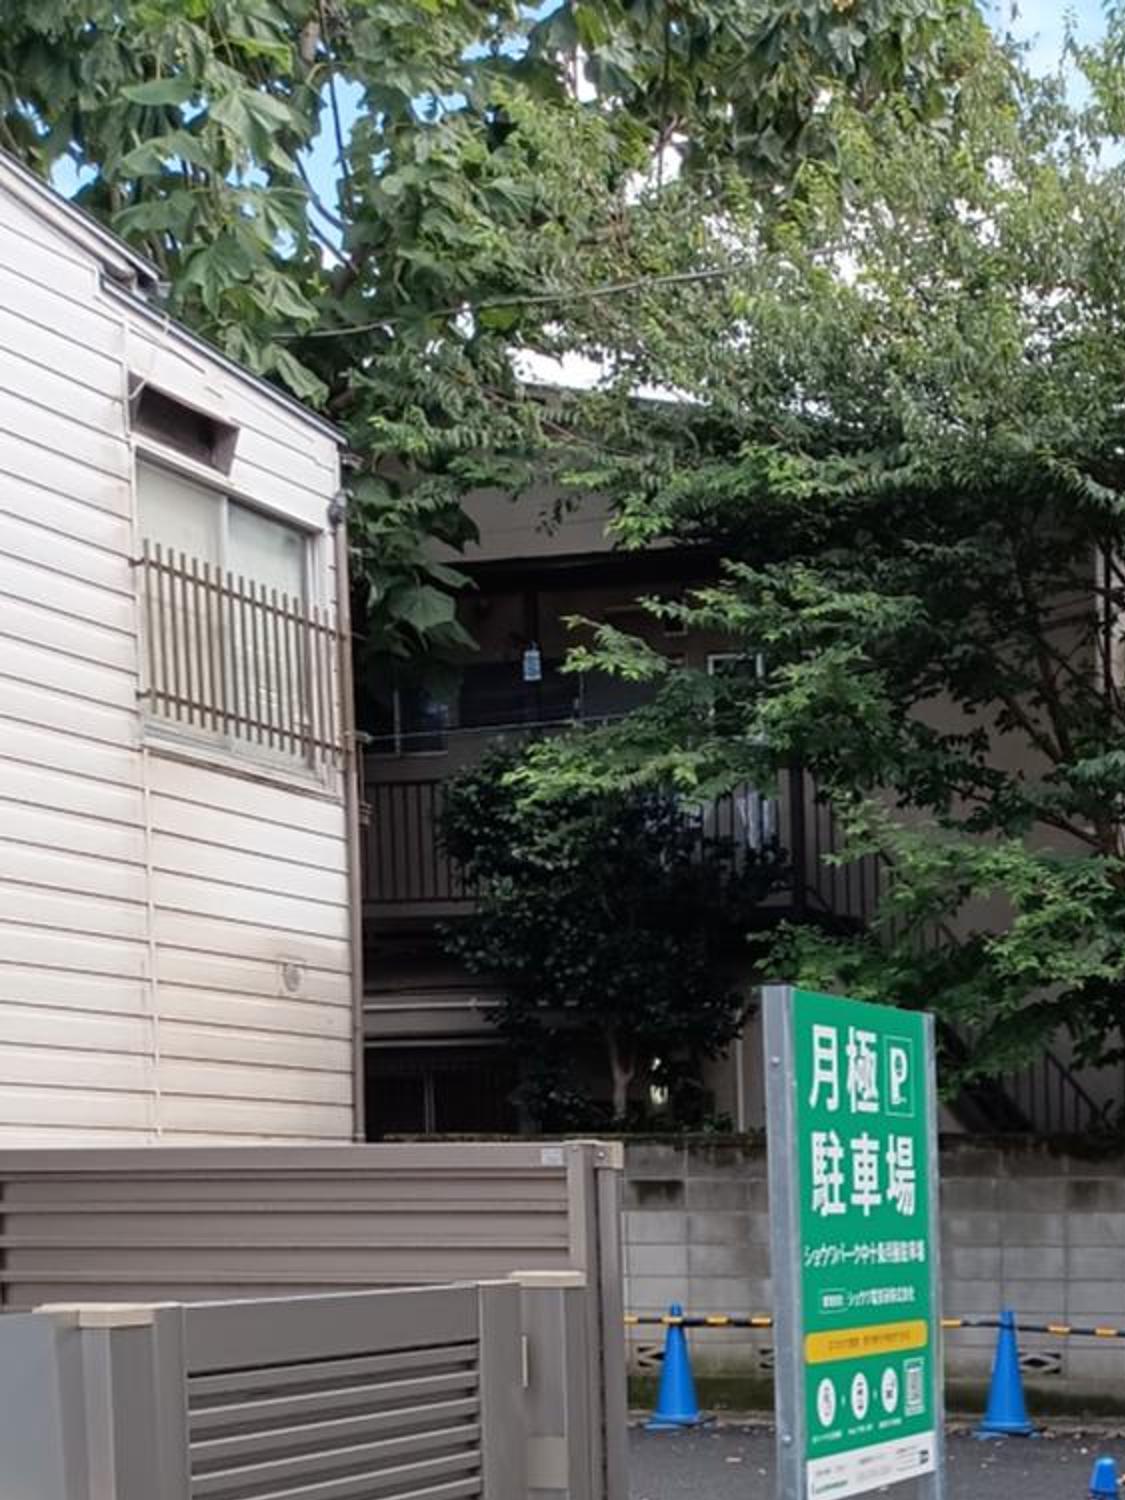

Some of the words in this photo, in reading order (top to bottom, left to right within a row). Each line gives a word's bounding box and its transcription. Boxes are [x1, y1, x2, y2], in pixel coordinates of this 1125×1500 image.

[809, 1025, 880, 1114] 月極
[811, 1128, 917, 1218] 駐車場
